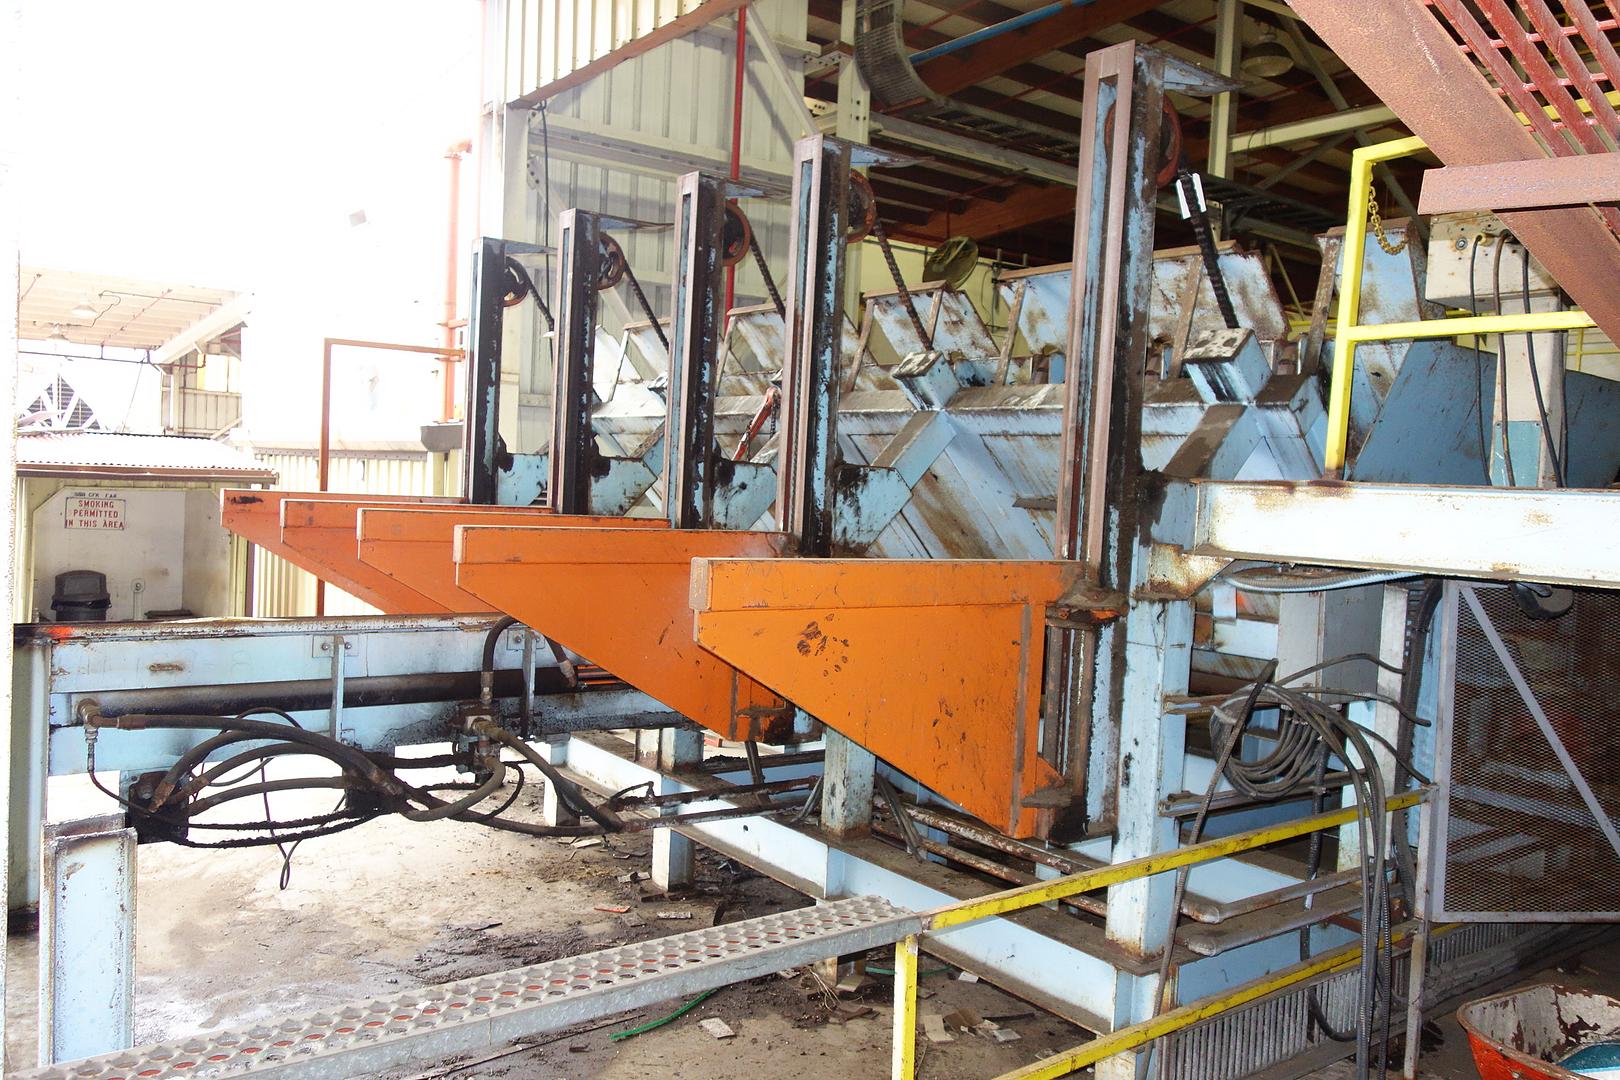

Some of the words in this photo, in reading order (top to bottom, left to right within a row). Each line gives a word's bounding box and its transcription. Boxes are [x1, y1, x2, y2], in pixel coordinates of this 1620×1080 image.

[79, 500, 114, 508] SMOKING
[73, 509, 119, 518] PERMITTED
[79, 520, 97, 528] THIS
[102, 520, 124, 529] AREA
